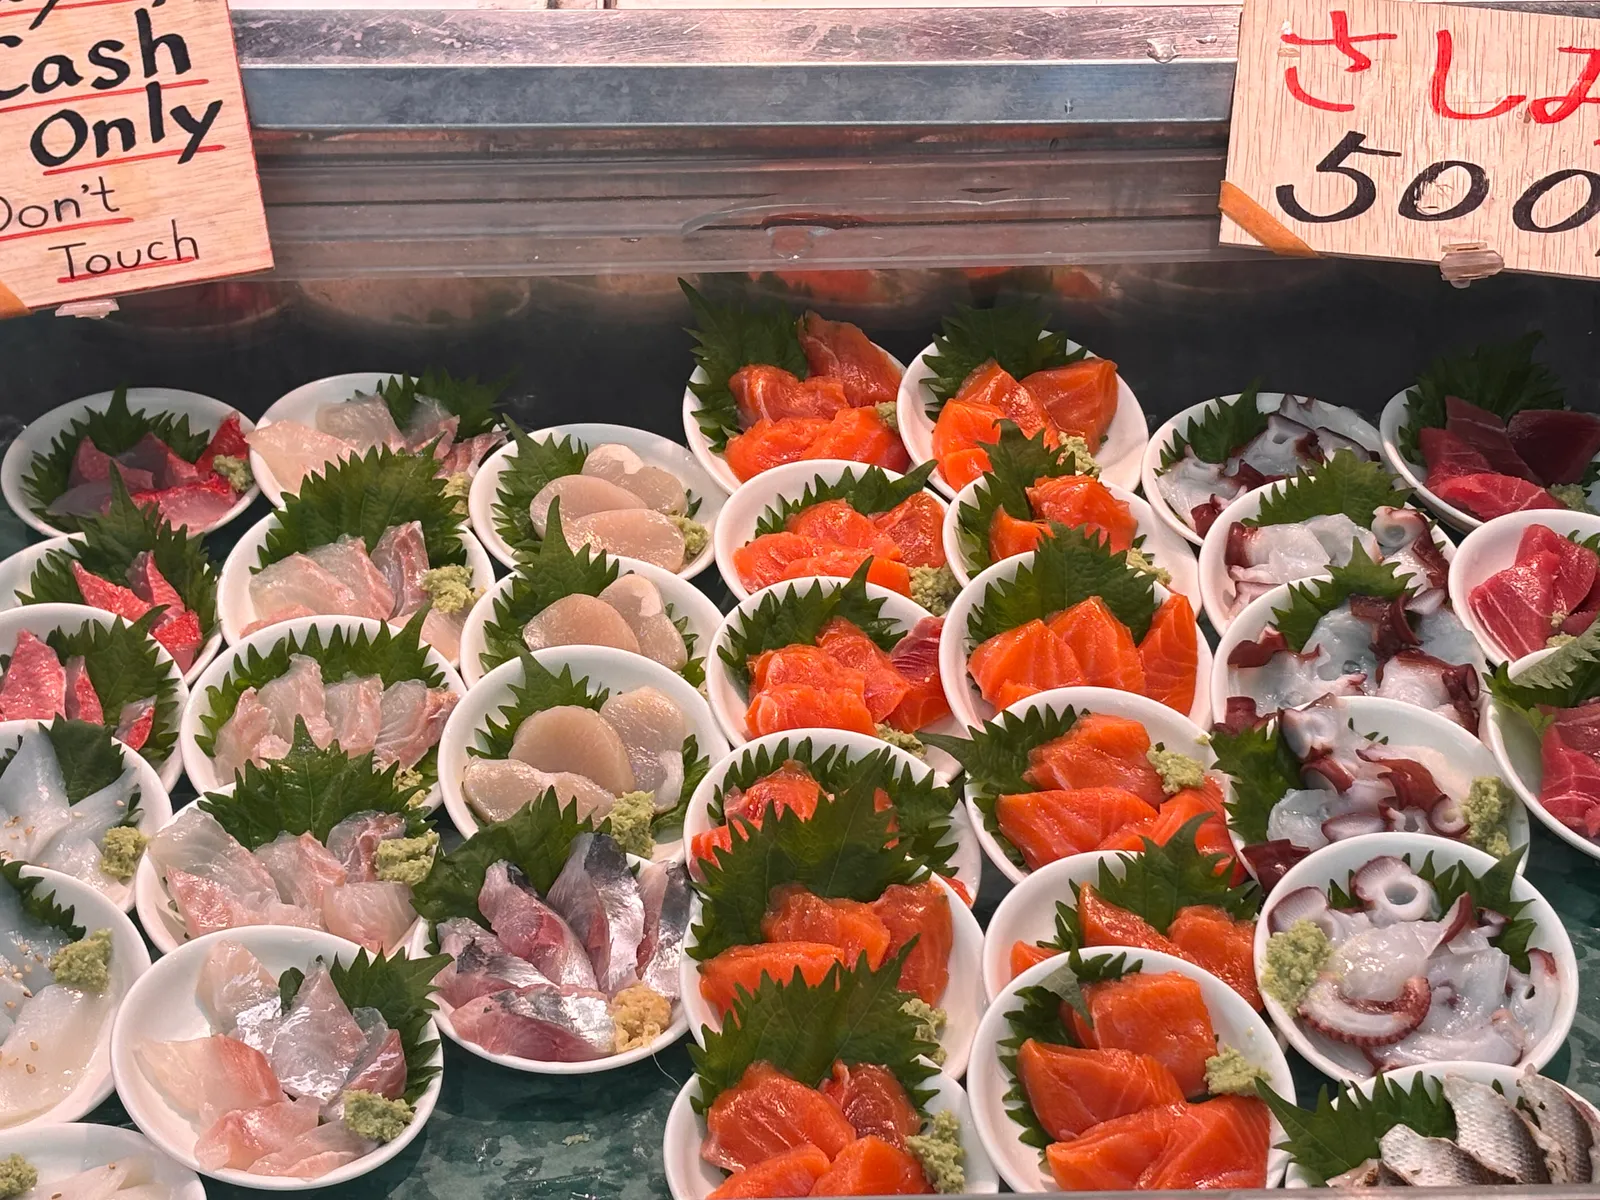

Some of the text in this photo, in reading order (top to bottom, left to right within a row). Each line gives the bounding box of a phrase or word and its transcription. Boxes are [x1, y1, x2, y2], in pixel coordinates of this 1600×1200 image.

[0, 8, 191, 99] Cash
[30, 81, 223, 167] Only
[1275, 131, 1600, 233] 500
[48, 219, 199, 279] Touch
